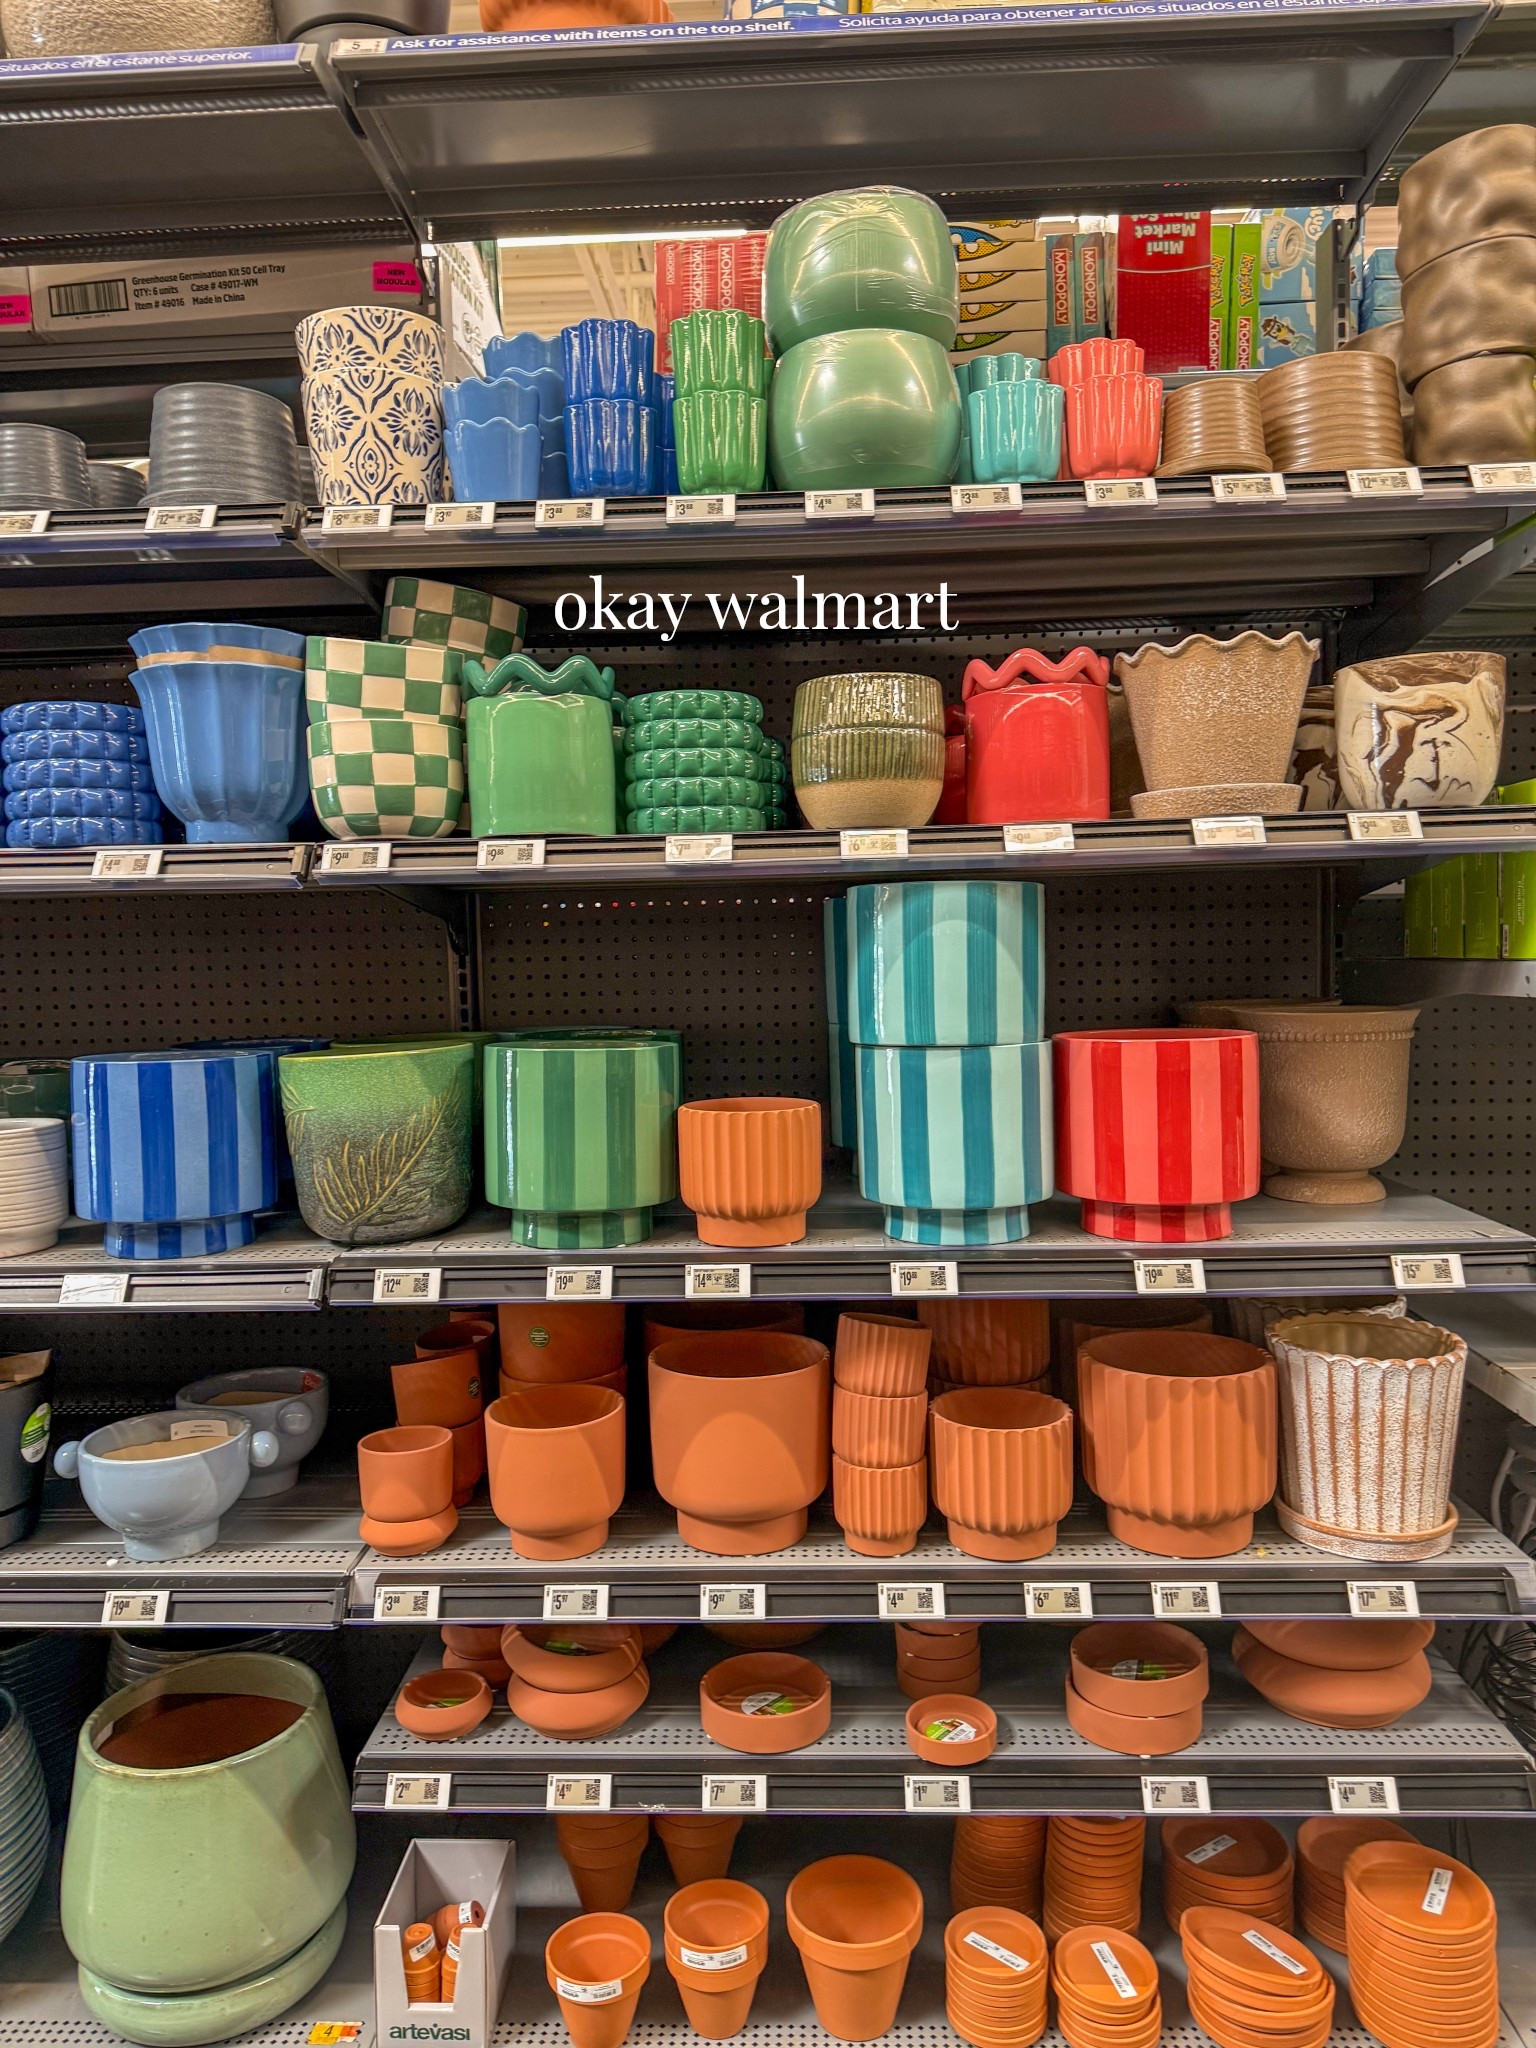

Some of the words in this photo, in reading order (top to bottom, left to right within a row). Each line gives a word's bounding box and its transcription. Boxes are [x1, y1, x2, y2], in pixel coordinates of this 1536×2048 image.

[839, 16, 902, 28] Solicita
[904, 13, 958, 26] ayuda
[962, 11, 1002, 23] para
[1004, 8, 1076, 20] obtener
[1079, 3, 1154, 16] artículos
[1158, 1, 1235, 13] situados
[392, 39, 425, 49] Ask
[428, 37, 454, 47] for
[458, 33, 550, 46] assistance
[554, 30, 594, 41] with
[597, 28, 647, 39] items
[649, 26, 674, 36] on
[677, 23, 708, 35] the
[710, 22, 740, 35] top
[745, 20, 795, 32] shelf.
[0, 60, 68, 73] situados
[113, 54, 179, 66] estante
[180, 51, 252, 64] superior.
[1135, 223, 1196, 238] Market
[1146, 240, 1184, 255] Mini
[132, 274, 178, 285] Greenhouse
[180, 269, 228, 282] Germination
[229, 268, 240, 277] Kit
[241, 267, 251, 276] 50
[252, 265, 267, 275] Cell
[268, 264, 286, 275] Tray
[377, 278, 416, 286] MODULAR
[692, 250, 703, 309] MONOPO
[720, 247, 732, 309] MONOPO
[133, 287, 152, 298] QTY:
[152, 287, 158, 295] 6
[159, 285, 179, 295] units
[190, 283, 210, 293] Case
[210, 282, 216, 290] #
[1055, 252, 1067, 323] MONOPOLY
[1084, 250, 1096, 321] MONOPOLY
[135, 301, 153, 311] Item
[154, 300, 160, 309] #
[161, 298, 185, 309] 49016
[192, 296, 214, 306] Made
[214, 294, 222, 304] in
[223, 293, 245, 303] China
[1209, 319, 1221, 370] ONOPOLY
[1238, 318, 1250, 369] ONOPOLY
[323, 2025, 334, 2036] 4
[389, 2023, 470, 2041] artevasi
